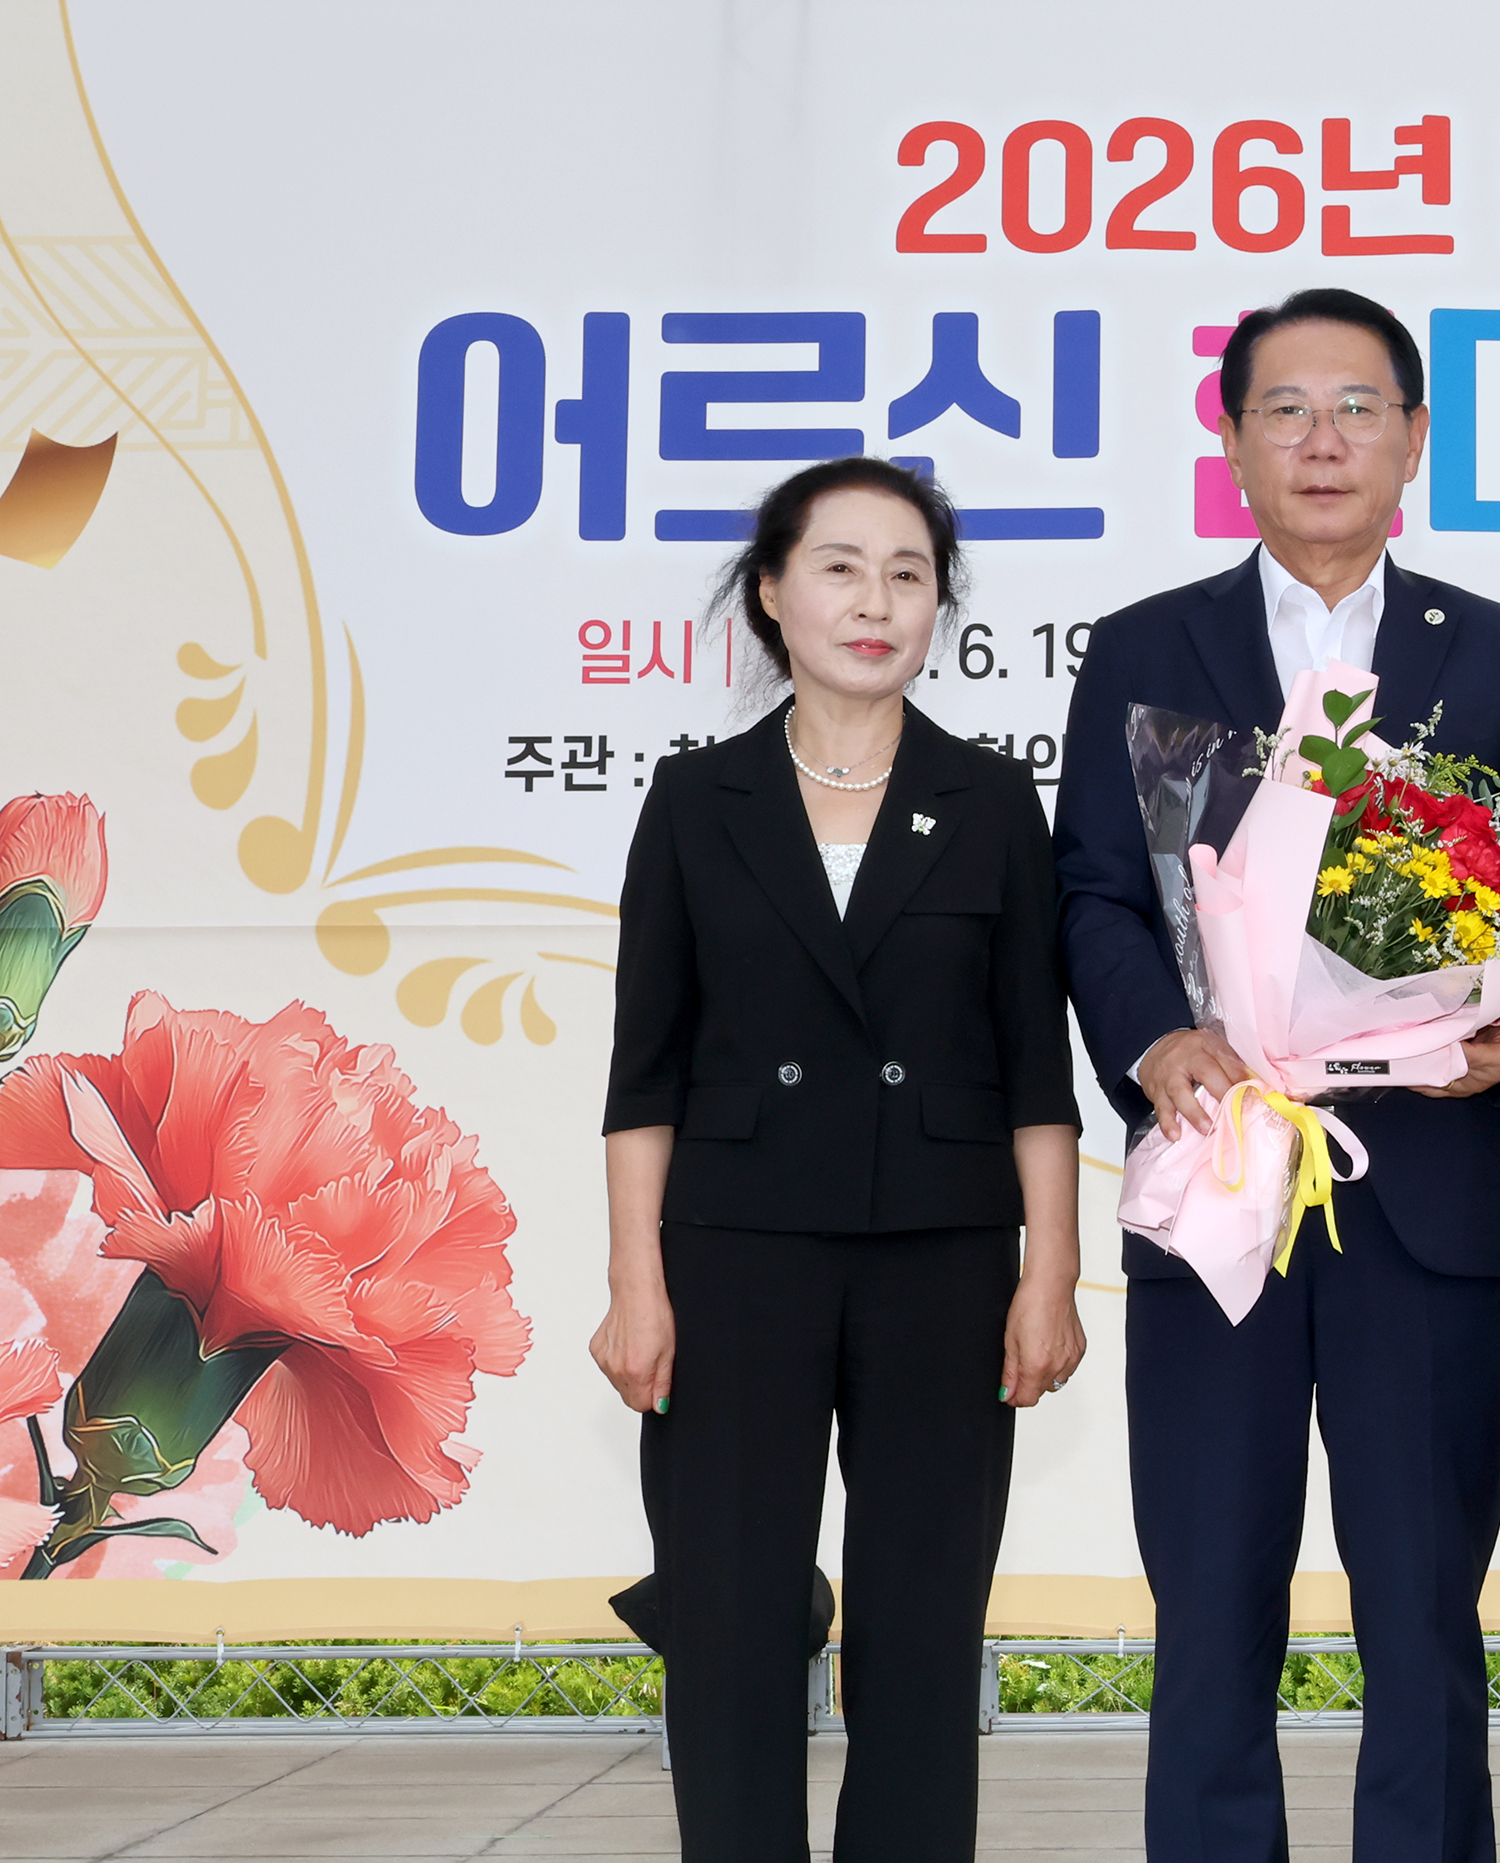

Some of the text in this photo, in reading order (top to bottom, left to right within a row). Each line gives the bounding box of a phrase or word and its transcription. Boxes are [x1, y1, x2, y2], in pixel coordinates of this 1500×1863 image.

[895, 114, 1455, 257] 2026년
[414, 310, 1105, 541] 어르신
[577, 619, 693, 684] 일시
[504, 734, 615, 793] 주관
